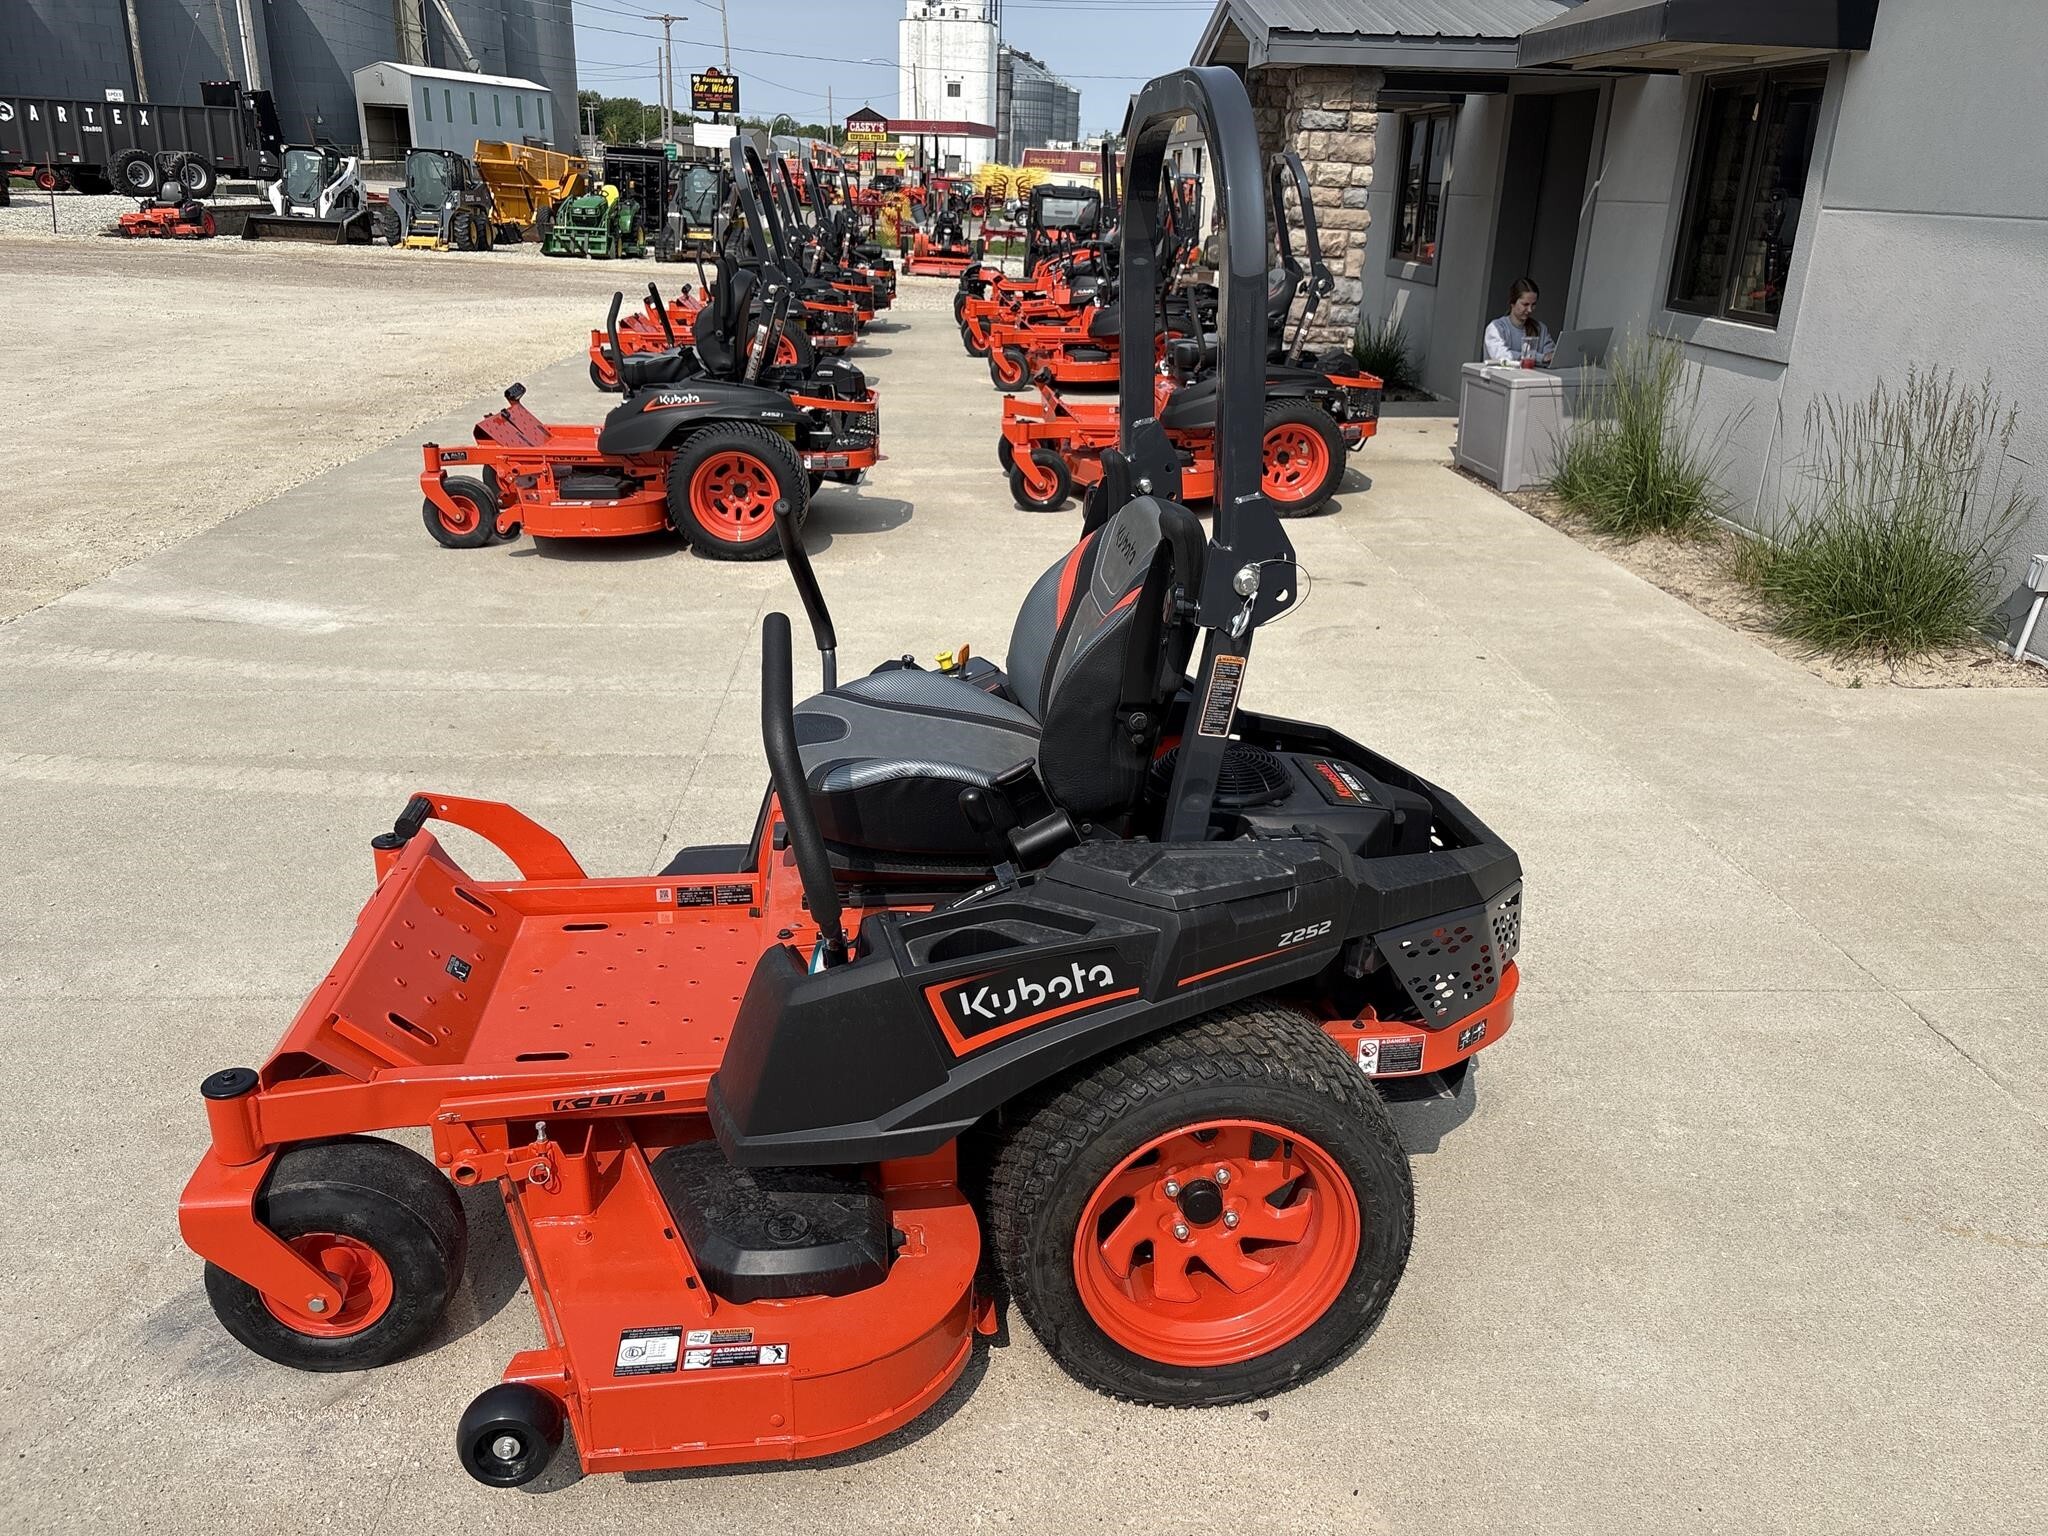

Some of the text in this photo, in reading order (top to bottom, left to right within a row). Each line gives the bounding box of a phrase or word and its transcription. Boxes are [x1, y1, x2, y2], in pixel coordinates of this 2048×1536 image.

[693, 82, 734, 93] Car Wash
[29, 105, 149, 126] ARTEX
[849, 122, 885, 132] CASEY'S
[659, 393, 700, 405] Kubota
[1277, 919, 1332, 948] Z252
[959, 962, 1114, 1019] Kubota
[557, 1090, 661, 1110] K-LIFT
